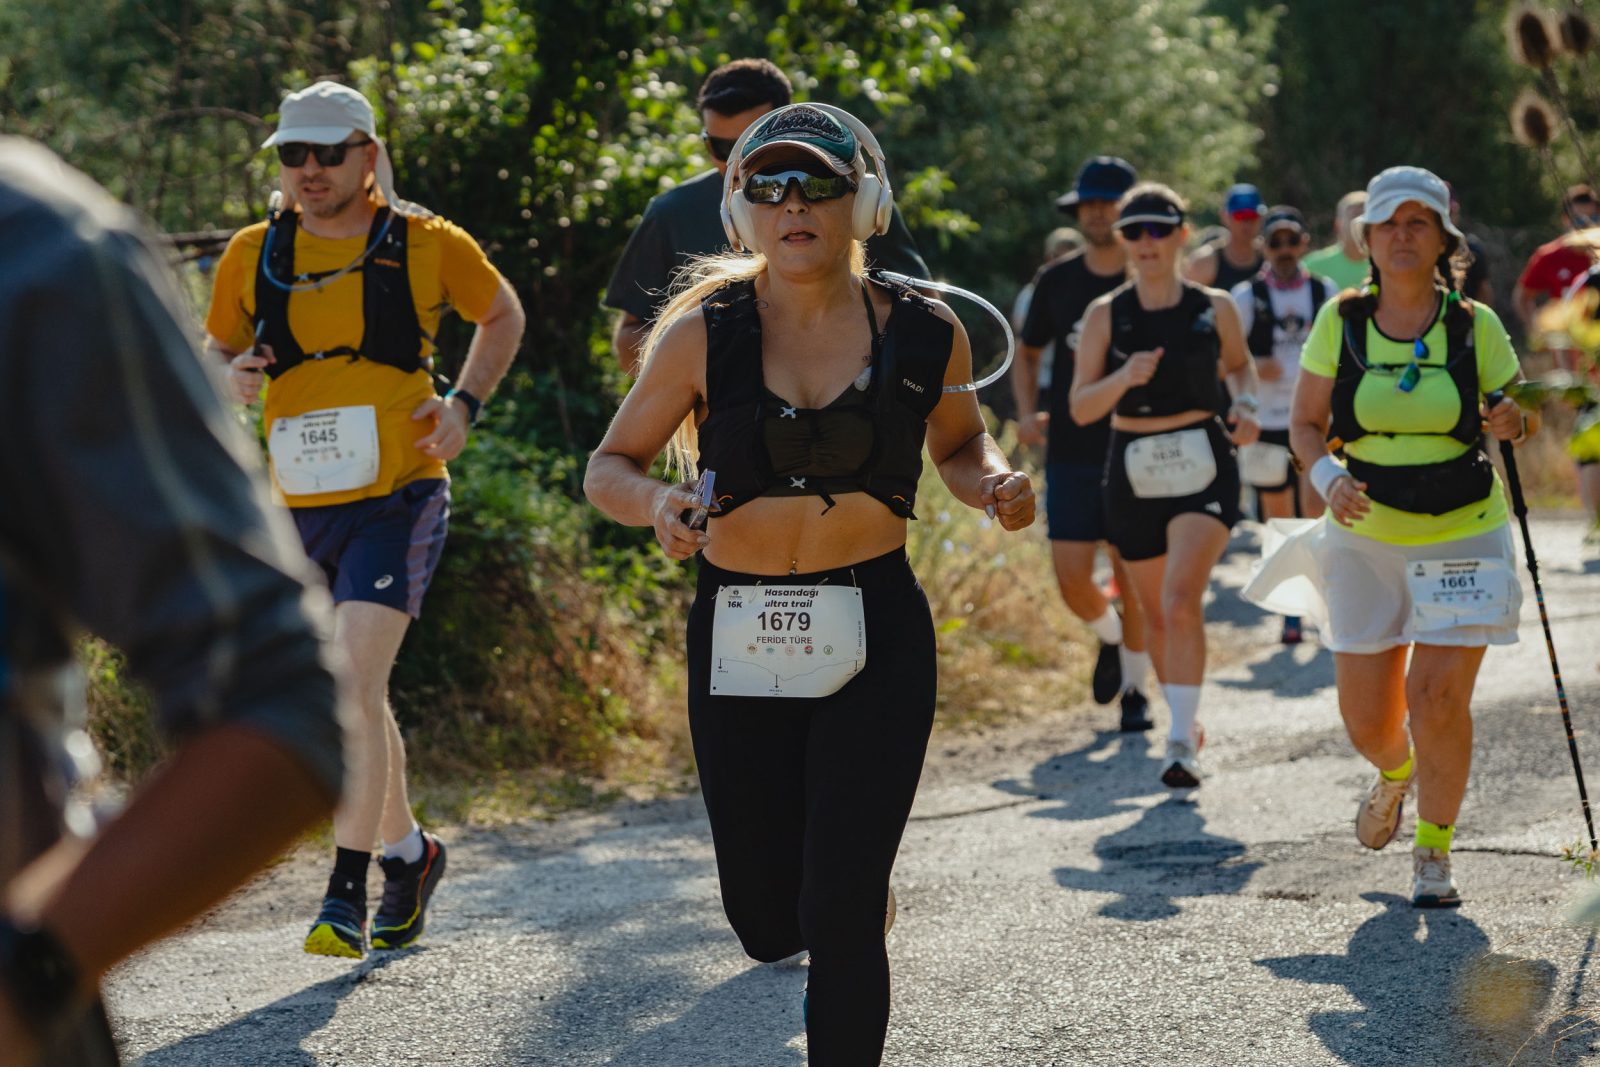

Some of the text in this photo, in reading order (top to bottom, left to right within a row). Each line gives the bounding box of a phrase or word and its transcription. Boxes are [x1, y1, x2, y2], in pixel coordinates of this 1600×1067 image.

[299, 427, 339, 446] 1645
[1440, 575, 1477, 589] 1661
[764, 588, 819, 599] Hasandağı
[727, 600, 743, 609] 16K
[764, 599, 813, 608] ultra trail
[757, 611, 812, 632] 1679
[756, 634, 813, 644] FERİDE TÜRE
